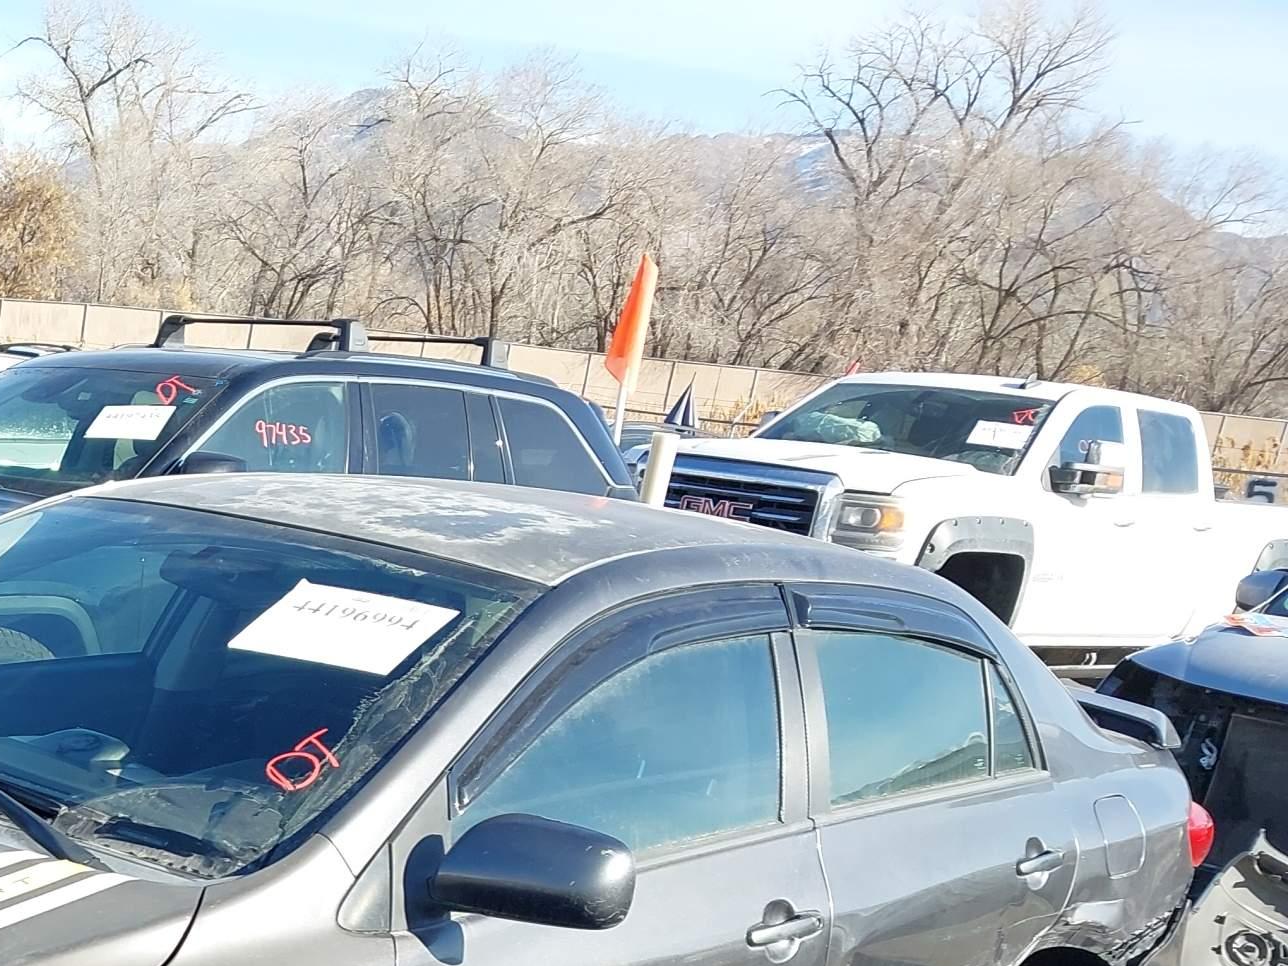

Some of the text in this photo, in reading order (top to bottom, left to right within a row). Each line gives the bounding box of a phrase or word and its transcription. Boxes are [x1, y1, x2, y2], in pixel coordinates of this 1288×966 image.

[255, 420, 312, 448] 97435
[679, 495, 754, 522] GMC
[292, 600, 421, 631] 44196994
